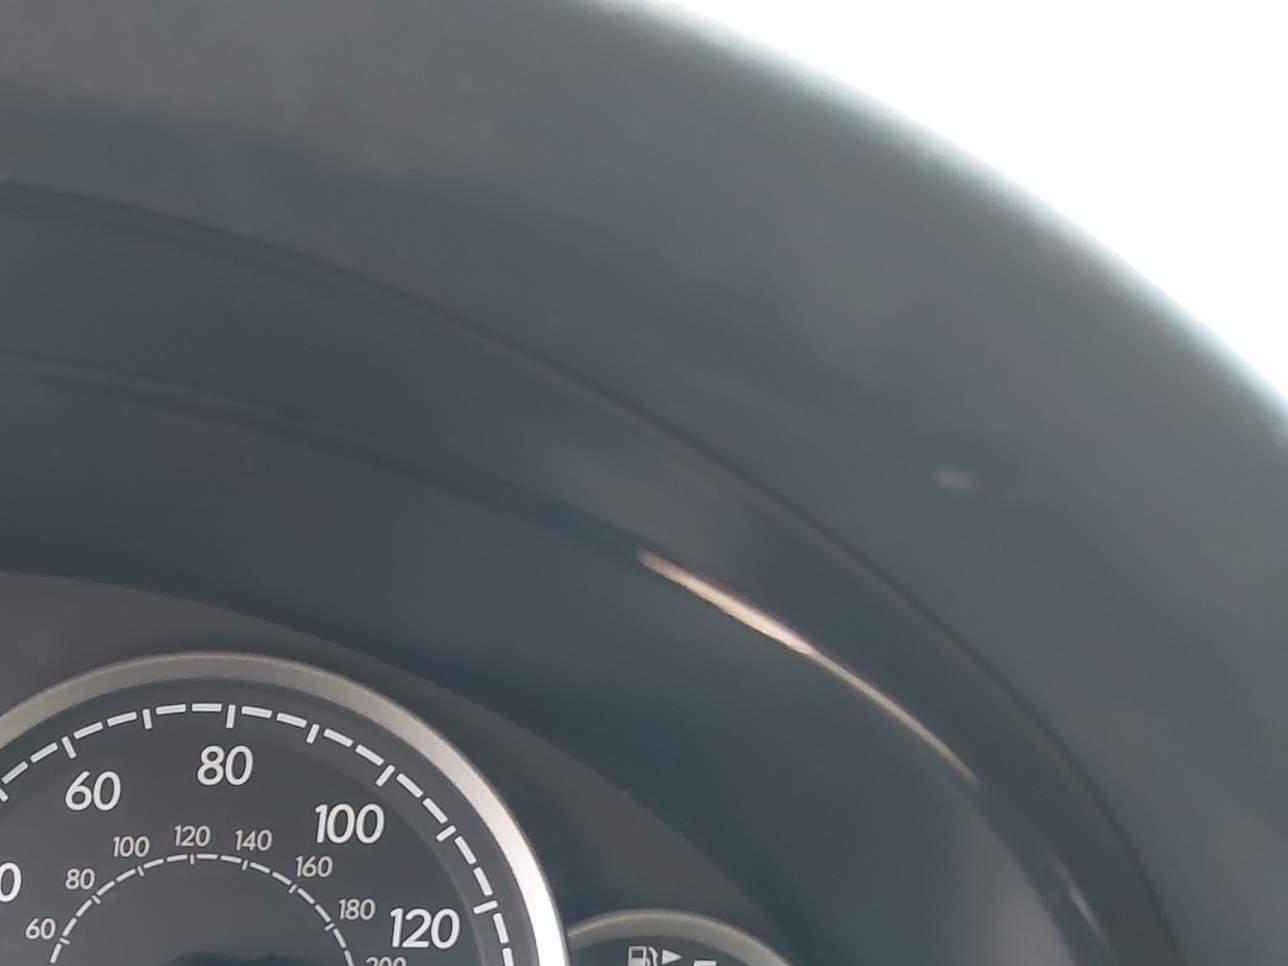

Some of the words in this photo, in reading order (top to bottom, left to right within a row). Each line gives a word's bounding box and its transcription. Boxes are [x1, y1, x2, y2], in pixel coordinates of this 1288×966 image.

[198, 746, 253, 785] 80
[66, 771, 120, 810] 60
[316, 804, 384, 843] 100
[175, 825, 210, 846] 120
[236, 830, 272, 851] 140
[113, 836, 149, 857] 100
[296, 856, 332, 877] 160
[66, 869, 95, 889] 80
[339, 899, 375, 920] 180
[26, 919, 55, 939] 60
[391, 908, 459, 948] 120
